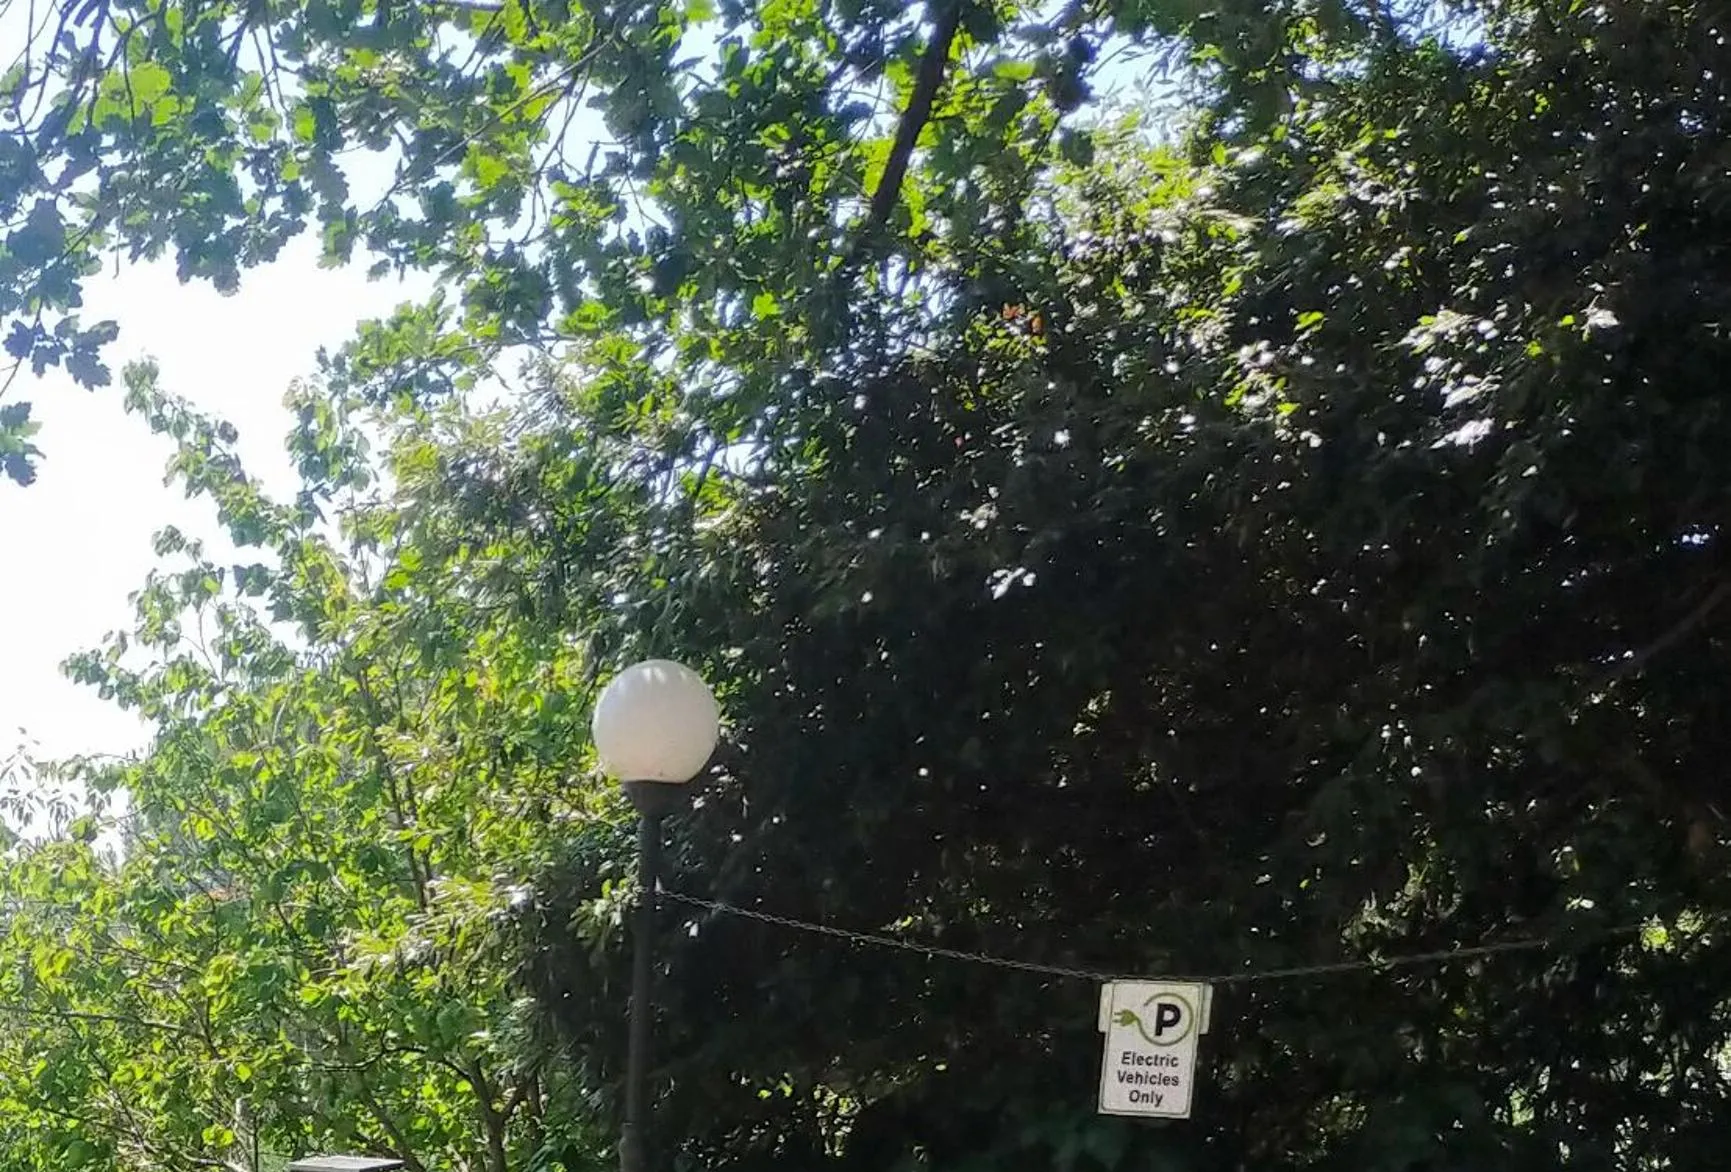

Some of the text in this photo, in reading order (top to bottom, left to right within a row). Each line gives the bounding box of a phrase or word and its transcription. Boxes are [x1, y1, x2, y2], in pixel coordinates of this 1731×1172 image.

[1155, 1002, 1181, 1036] P
[1121, 1051, 1179, 1067] Electric
[1117, 1070, 1180, 1086] Vehicles
[1128, 1089, 1164, 1107] Only
